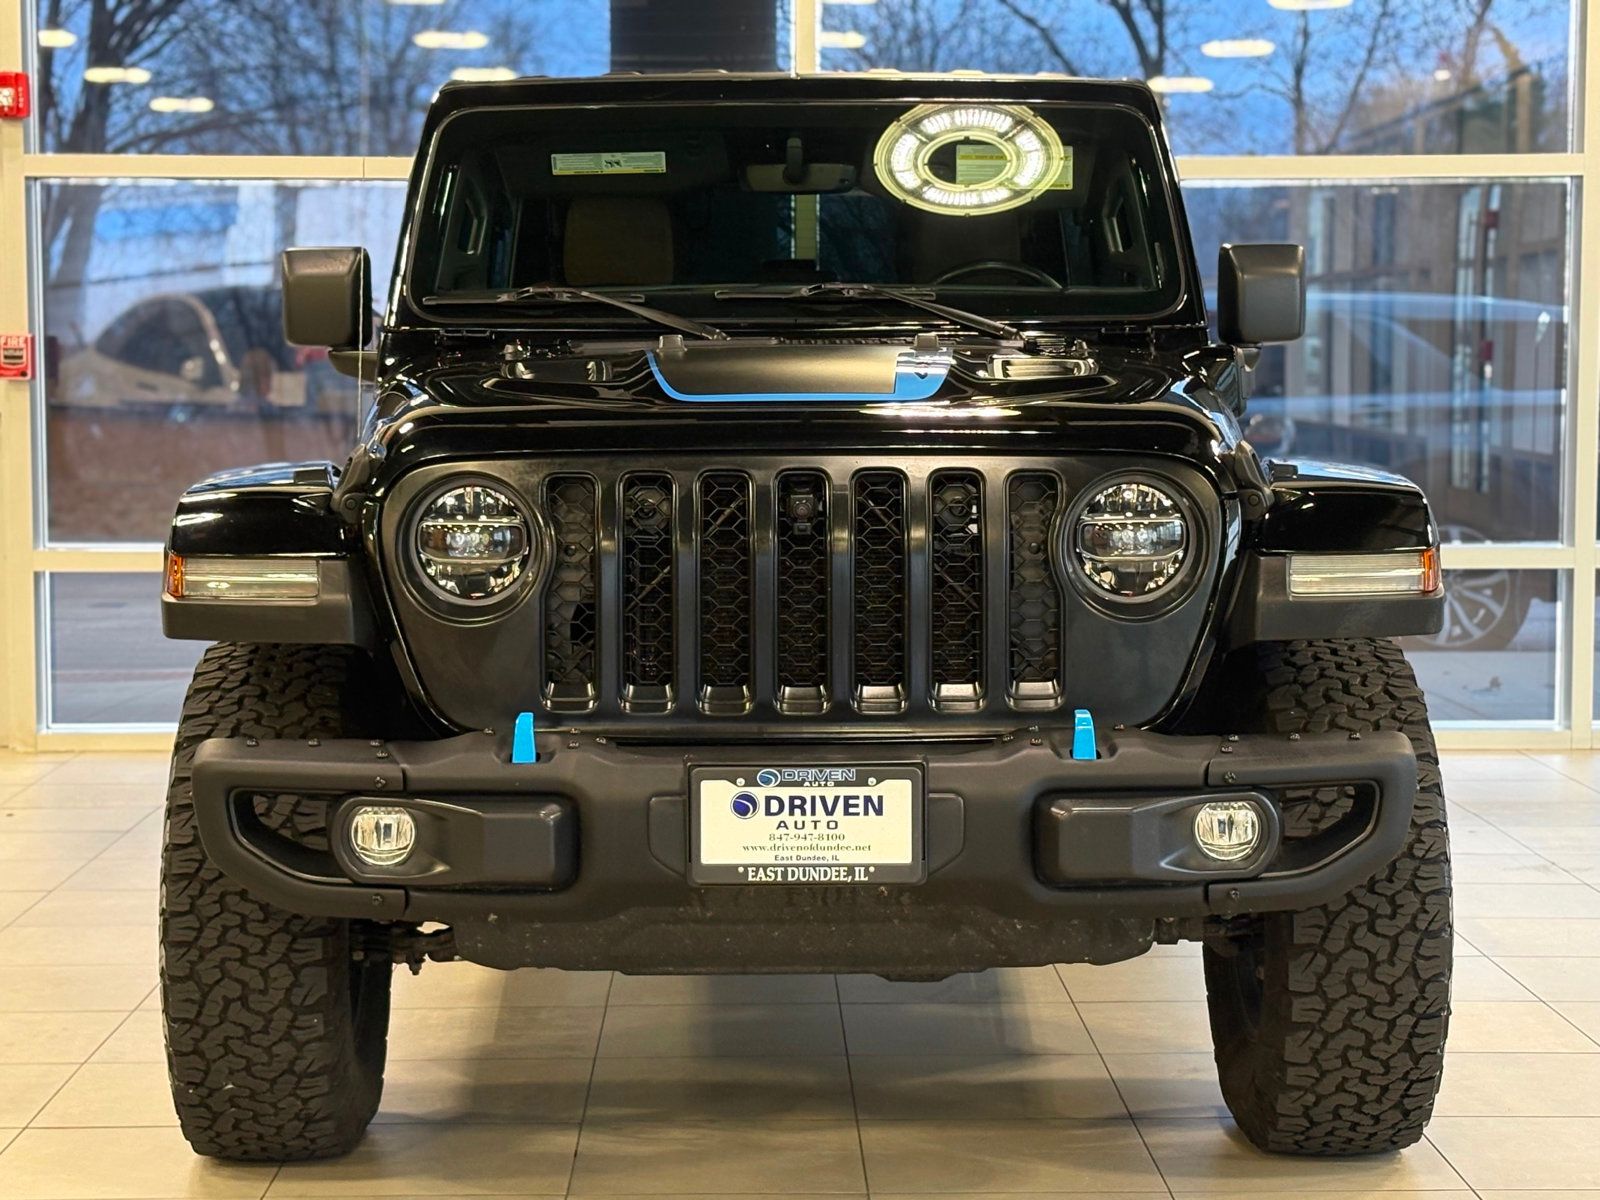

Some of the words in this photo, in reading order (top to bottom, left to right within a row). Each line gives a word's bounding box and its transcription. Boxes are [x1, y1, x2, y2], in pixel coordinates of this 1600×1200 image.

[781, 769, 856, 781] DRIVEN
[764, 795, 884, 816] DRIVEN
[776, 820, 839, 830] AUTO
[768, 833, 845, 841] 847-947-8100
[796, 854, 829, 862] Dundee,
[747, 866, 784, 881] EAST
[787, 866, 852, 882] DUNDEE,
[854, 866, 868, 881] IL
